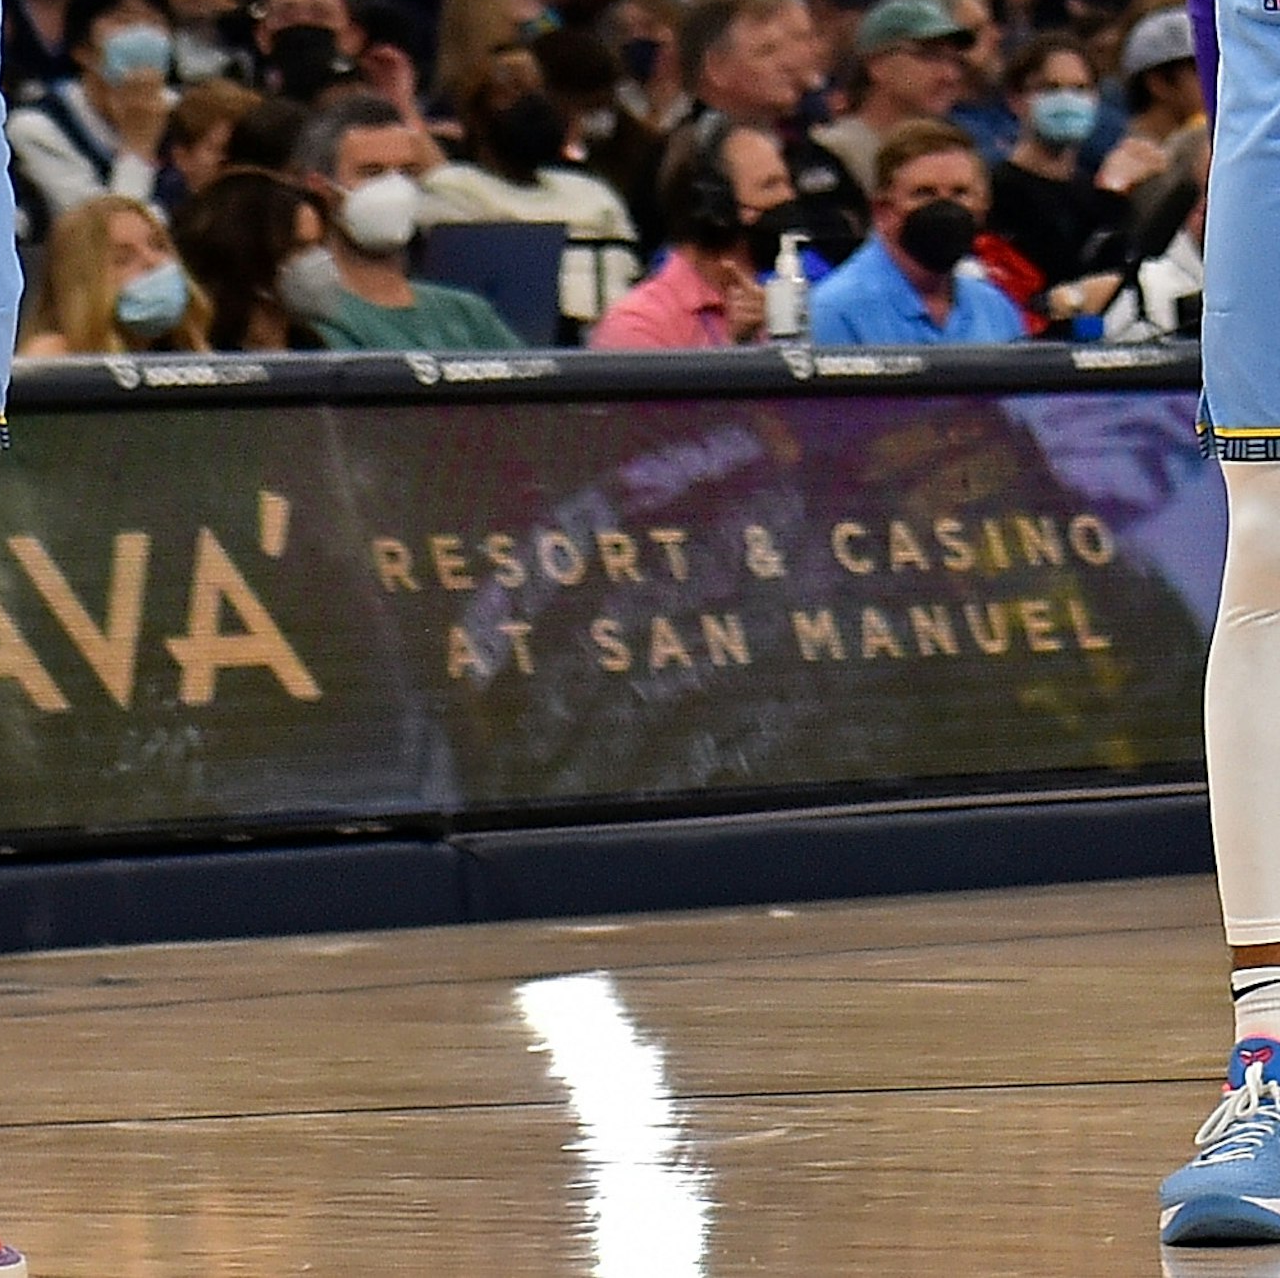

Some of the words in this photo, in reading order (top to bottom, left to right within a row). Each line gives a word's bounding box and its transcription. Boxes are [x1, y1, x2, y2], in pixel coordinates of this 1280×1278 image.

[372, 527, 690, 592] RESORT
[743, 524, 787, 579] &
[830, 513, 1116, 574] CASINO
[446, 623, 536, 679] AT
[589, 614, 753, 672] SAN
[790, 600, 1114, 661] MANUEL
